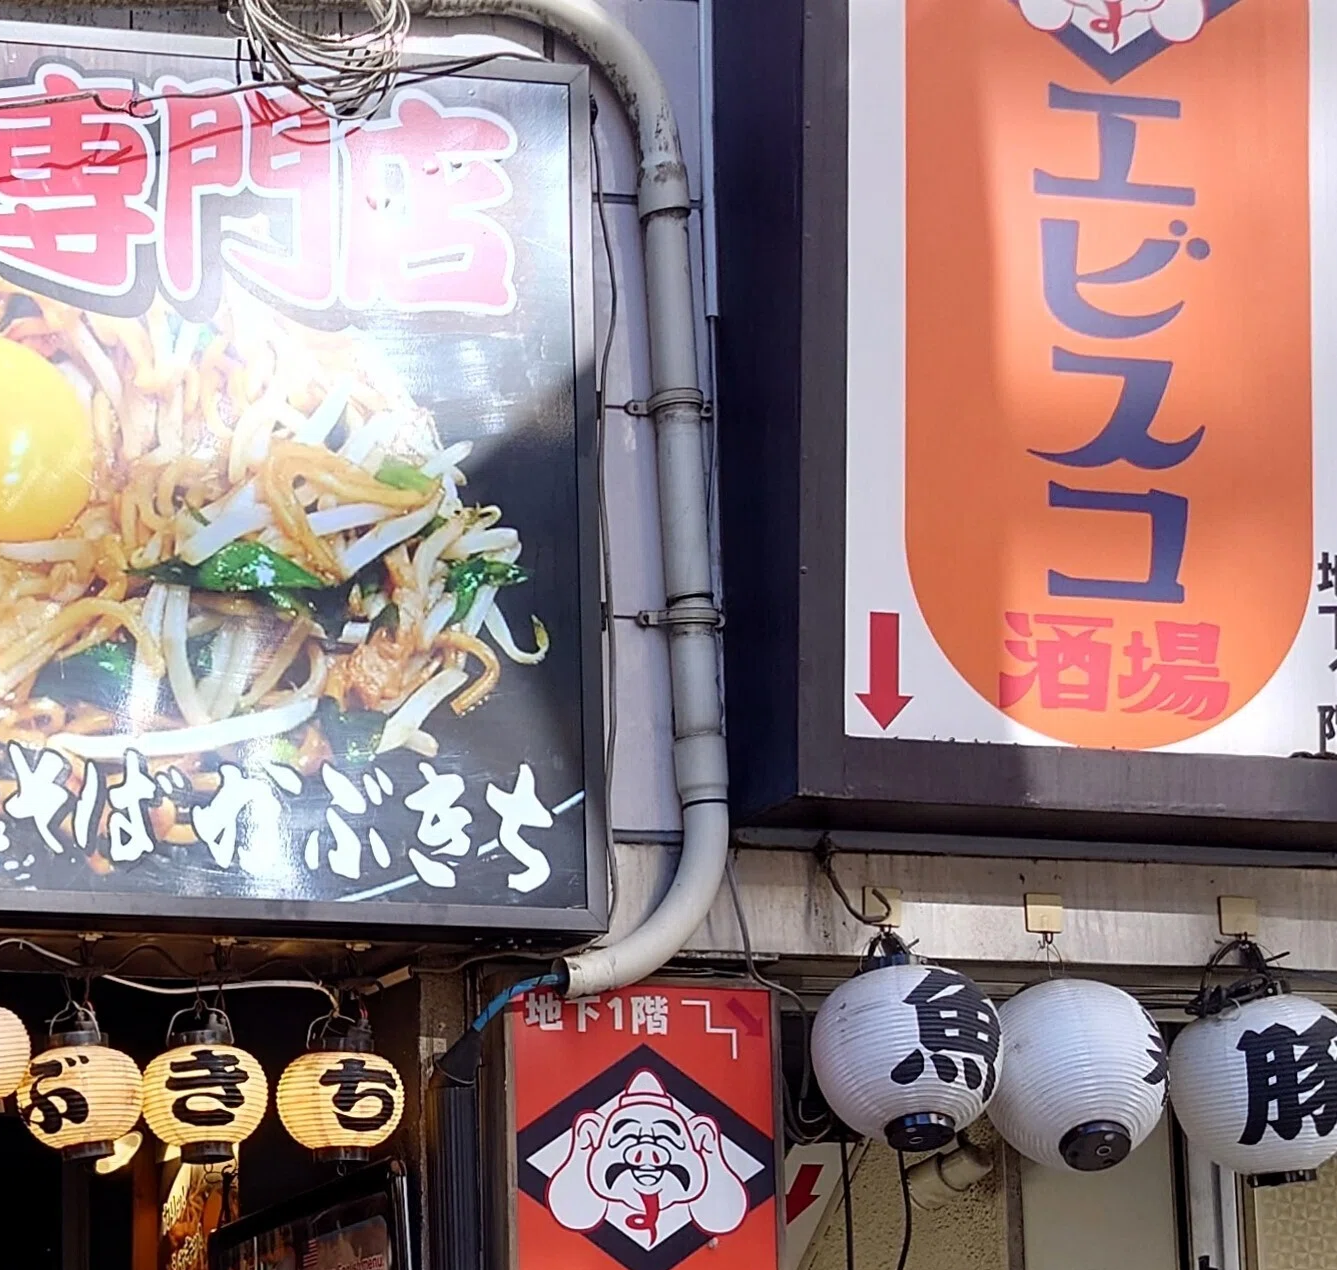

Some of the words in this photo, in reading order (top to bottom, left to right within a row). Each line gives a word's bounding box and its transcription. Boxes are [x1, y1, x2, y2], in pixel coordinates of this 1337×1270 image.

[1026, 80, 1212, 605] エビスコ
[998, 609, 1231, 722] 酒場
[525, 993, 670, 1036] 地下1階
[890, 966, 1002, 1103] 魚
[164, 1049, 251, 1127] き
[319, 1057, 397, 1133] ち
